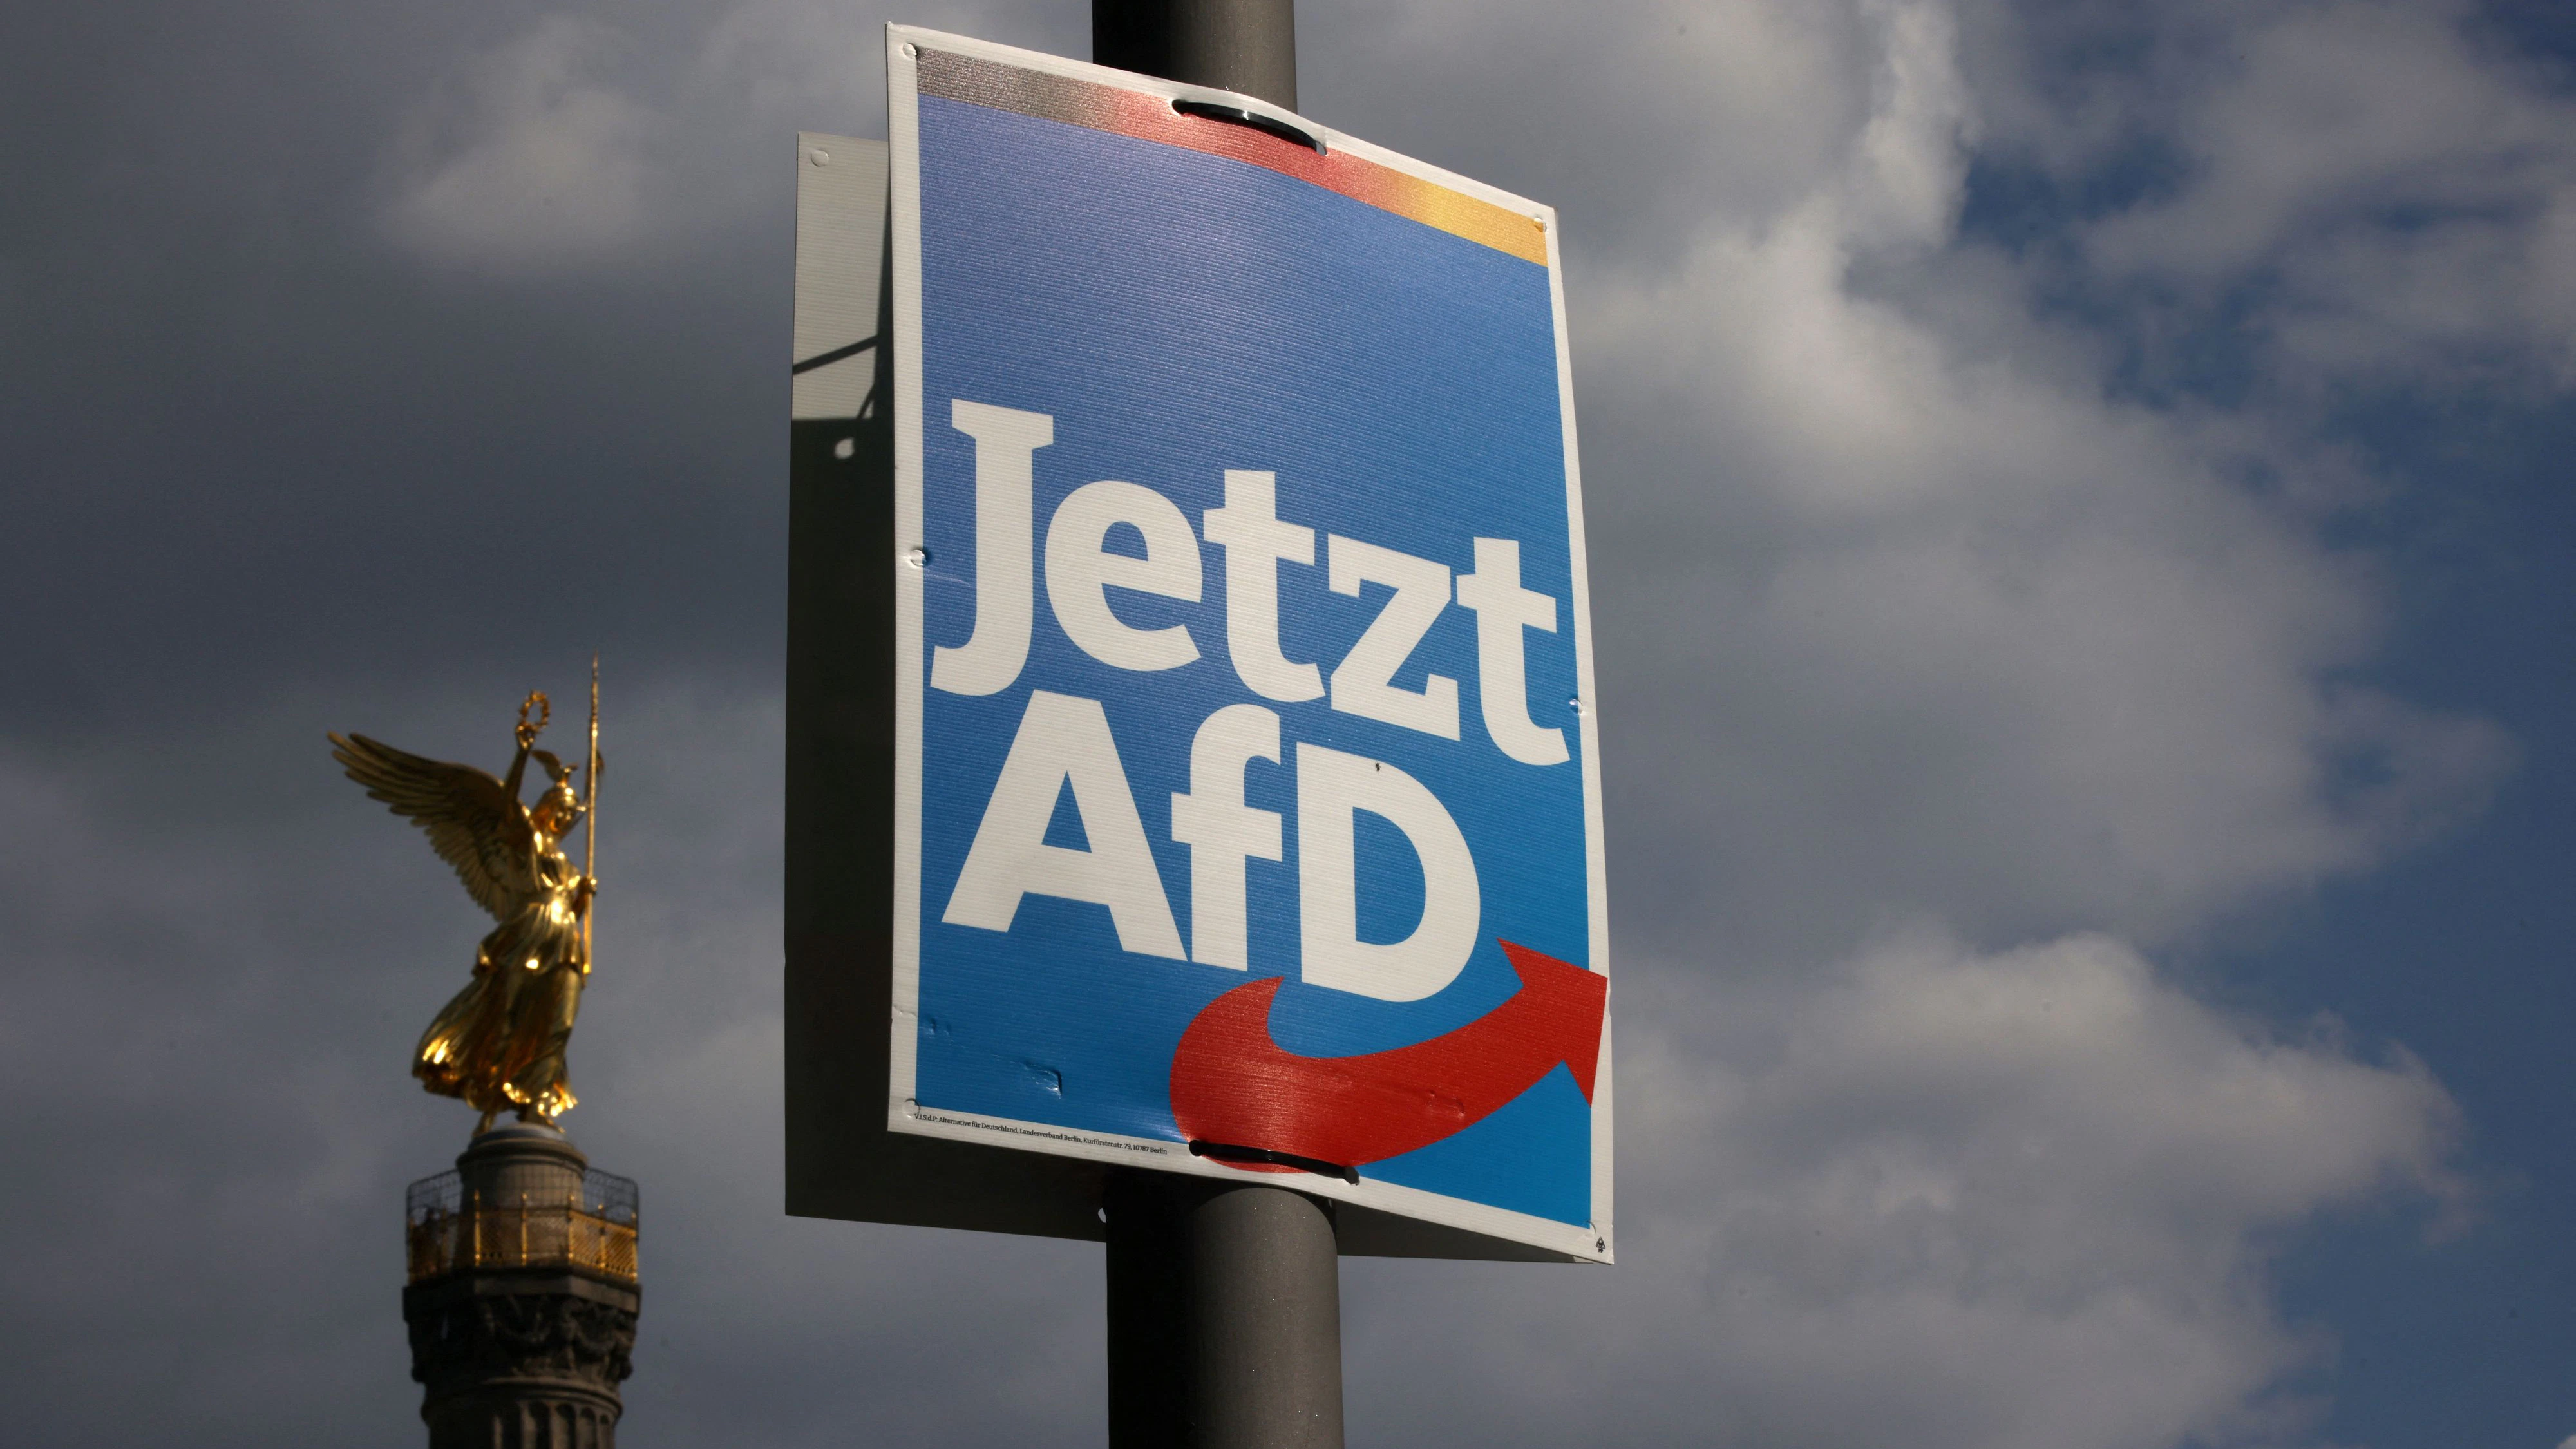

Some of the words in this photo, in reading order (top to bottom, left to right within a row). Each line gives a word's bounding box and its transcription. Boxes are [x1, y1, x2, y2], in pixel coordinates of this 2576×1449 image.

[930, 398, 1571, 766] Jetzt
[942, 688, 1481, 1003] AfD
[939, 1117, 971, 1126] Alternative
[981, 1123, 1019, 1134] Deutschland,
[1019, 1128, 1063, 1140] Landesverband
[1064, 1135, 1083, 1143] Berlin,
[1083, 1137, 1123, 1148] Kurfürstenstr.
